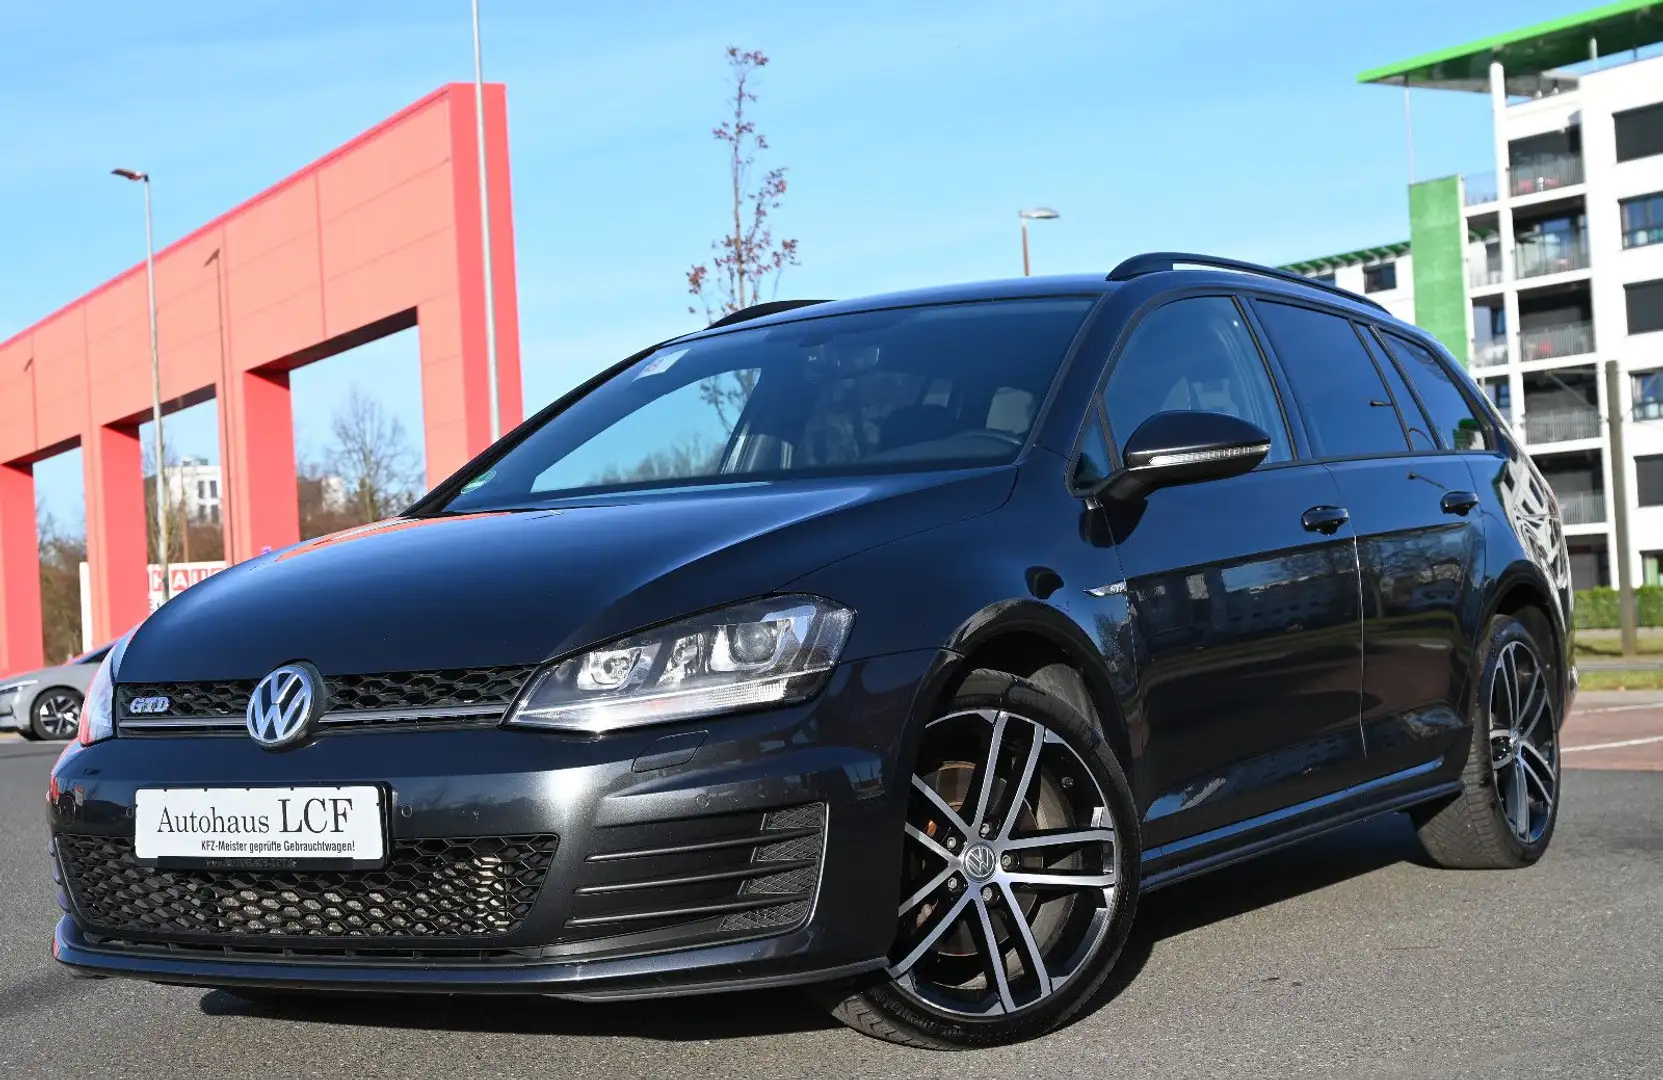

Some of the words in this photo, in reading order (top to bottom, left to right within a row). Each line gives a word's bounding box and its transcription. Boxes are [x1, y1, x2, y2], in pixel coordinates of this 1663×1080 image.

[129, 696, 170, 714] GTD
[157, 806, 269, 833] Autohaus
[278, 798, 353, 833] LCF
[201, 840, 247, 852] KFZ-Meister
[249, 840, 281, 853] geprüfte
[283, 840, 355, 853] Gebrauchtwagen!
